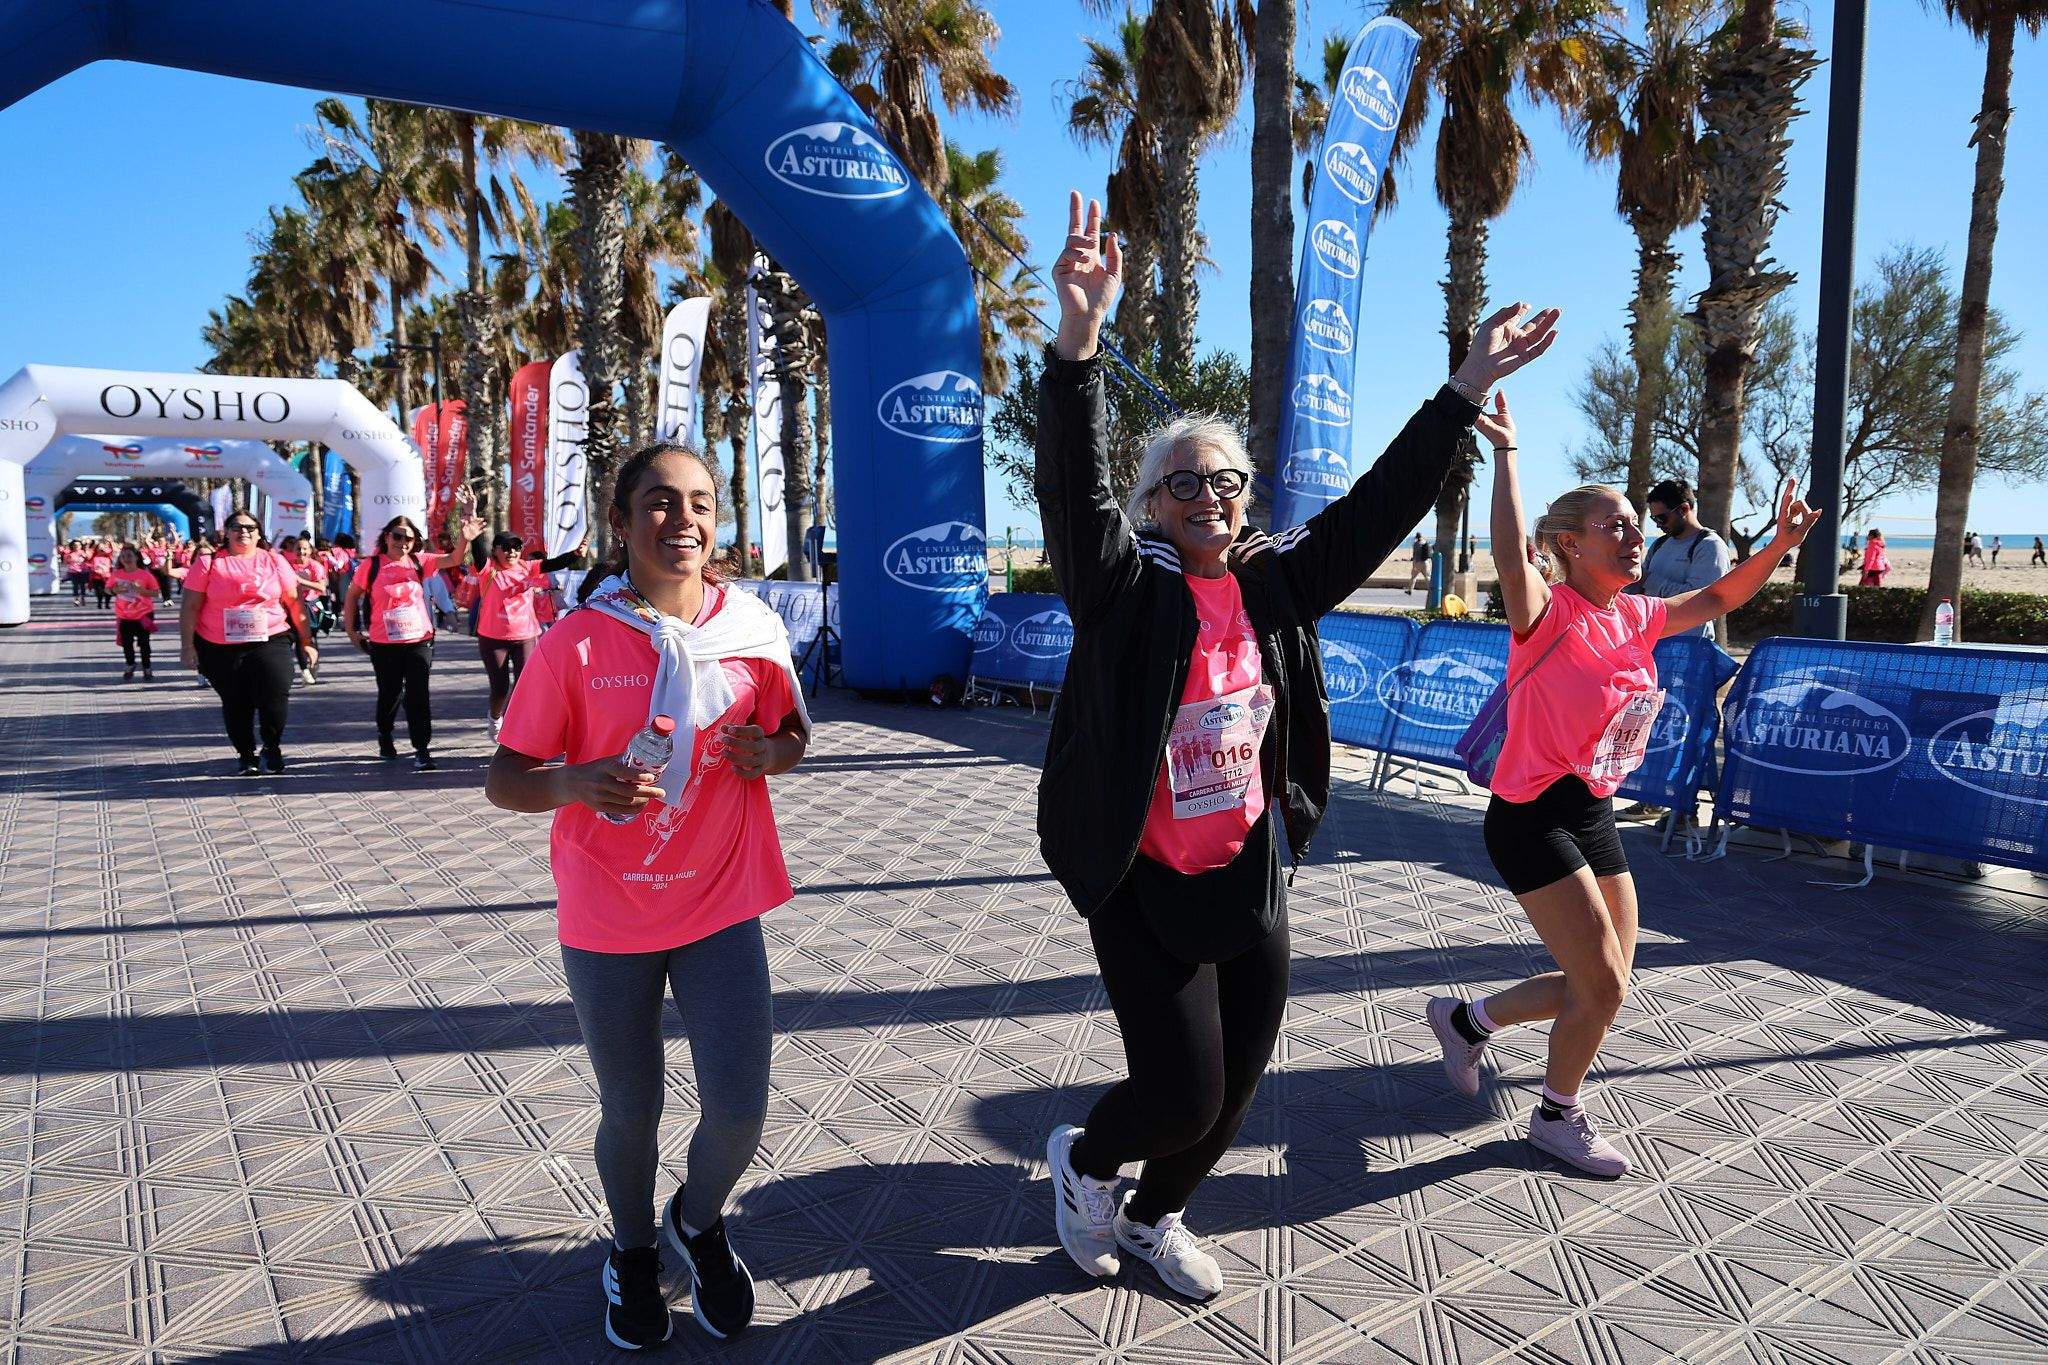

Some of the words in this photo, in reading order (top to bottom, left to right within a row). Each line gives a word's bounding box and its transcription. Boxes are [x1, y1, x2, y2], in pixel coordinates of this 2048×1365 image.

[778, 144, 905, 185] ASTURIANA
[665, 333, 696, 439] SHO
[101, 384, 290, 424] OYSHO
[889, 395, 981, 426] ASTURIAN
[521, 384, 539, 469] Santander
[556, 381, 585, 531] OYSHO
[73, 486, 163, 496] VOLVO
[895, 548, 986, 575] ASTURIAN
[1803, 597, 1820, 607] 116
[591, 674, 649, 690] OYSHO
[1383, 680, 1484, 716] ASTURIAN
[1824, 715, 1890, 731] LECHERA
[1212, 743, 1253, 769] 016
[1943, 731, 2048, 777] ASTU
[1189, 786, 1215, 798] CARRERA
[1223, 781, 1231, 789] LA
[1188, 796, 1225, 812] OYSHO
[622, 872, 654, 882] CARRERA
[655, 874, 664, 882] DE
[674, 870, 697, 880] MUJER
